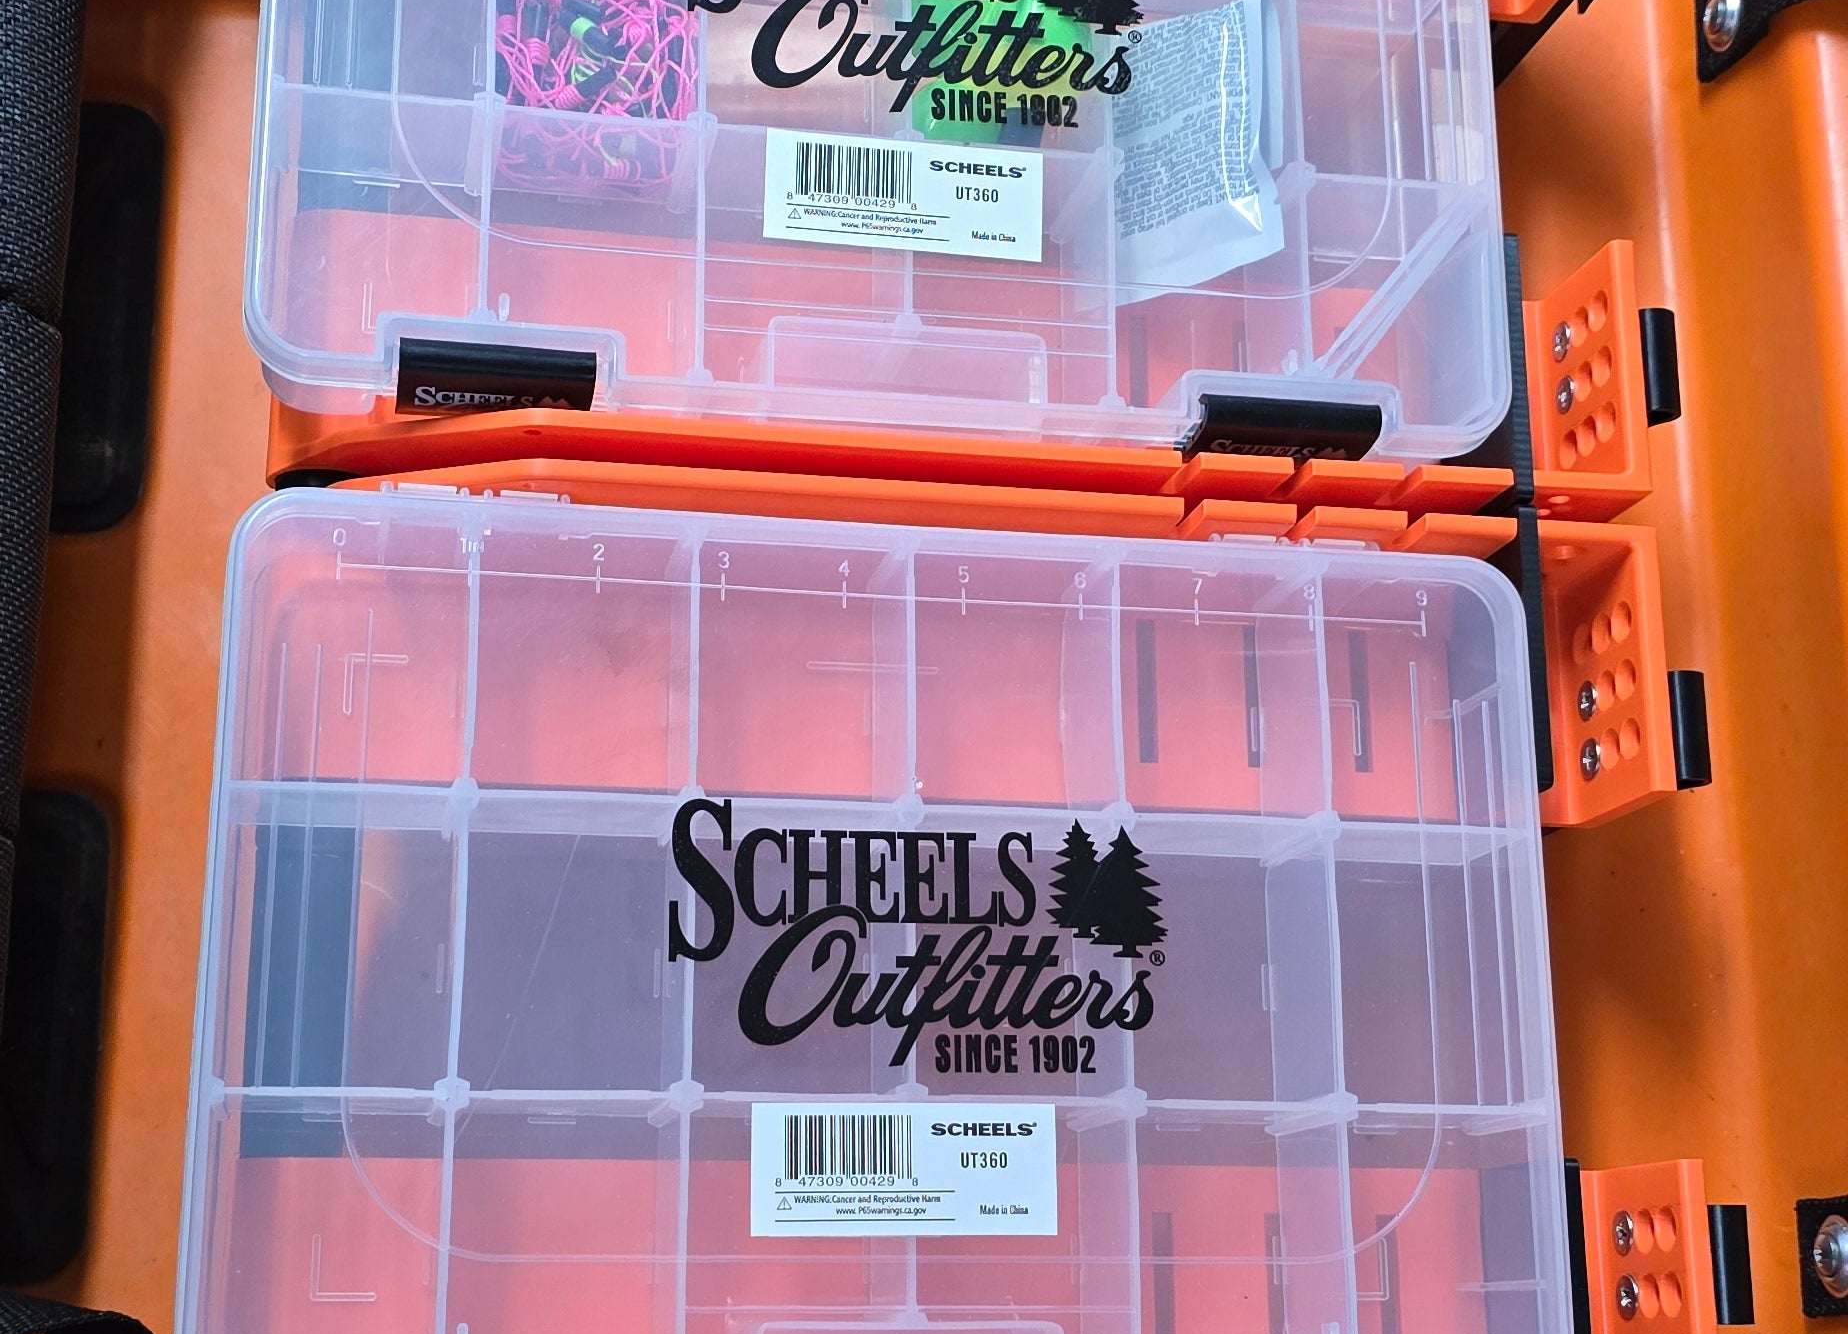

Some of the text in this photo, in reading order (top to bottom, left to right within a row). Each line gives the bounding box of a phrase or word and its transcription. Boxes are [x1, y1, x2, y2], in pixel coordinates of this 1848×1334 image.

[930, 86, 1079, 128] SINCE 1902
[929, 159, 1024, 179] SCHEELS
[786, 192, 793, 200] 8
[808, 193, 849, 205] 47309
[854, 196, 896, 209] 00429
[955, 185, 999, 203] UT360
[971, 230, 990, 241] Made
[991, 231, 997, 241] in
[414, 385, 533, 408] SCHEELS
[333, 527, 346, 547] 0
[592, 543, 605, 562] 2
[718, 551, 730, 569] 3
[838, 559, 850, 577] 4
[957, 566, 969, 583] 5
[1074, 571, 1086, 589] 6
[1193, 577, 1203, 595] 7
[1303, 584, 1316, 599] 8
[1415, 590, 1428, 606] 9
[667, 798, 1037, 962] SCHEELS
[737, 904, 1155, 1067] Outfitters
[934, 1033, 1097, 1073] SINCE 1902
[931, 1122, 1034, 1136] SCHEELS
[961, 1152, 1007, 1168] UT360
[775, 1176, 919, 1187] 8 47309 00429 8
[832, 1195, 856, 1204] Cancer
[858, 1195, 871, 1204] and
[980, 1204, 1028, 1215] Made in China
